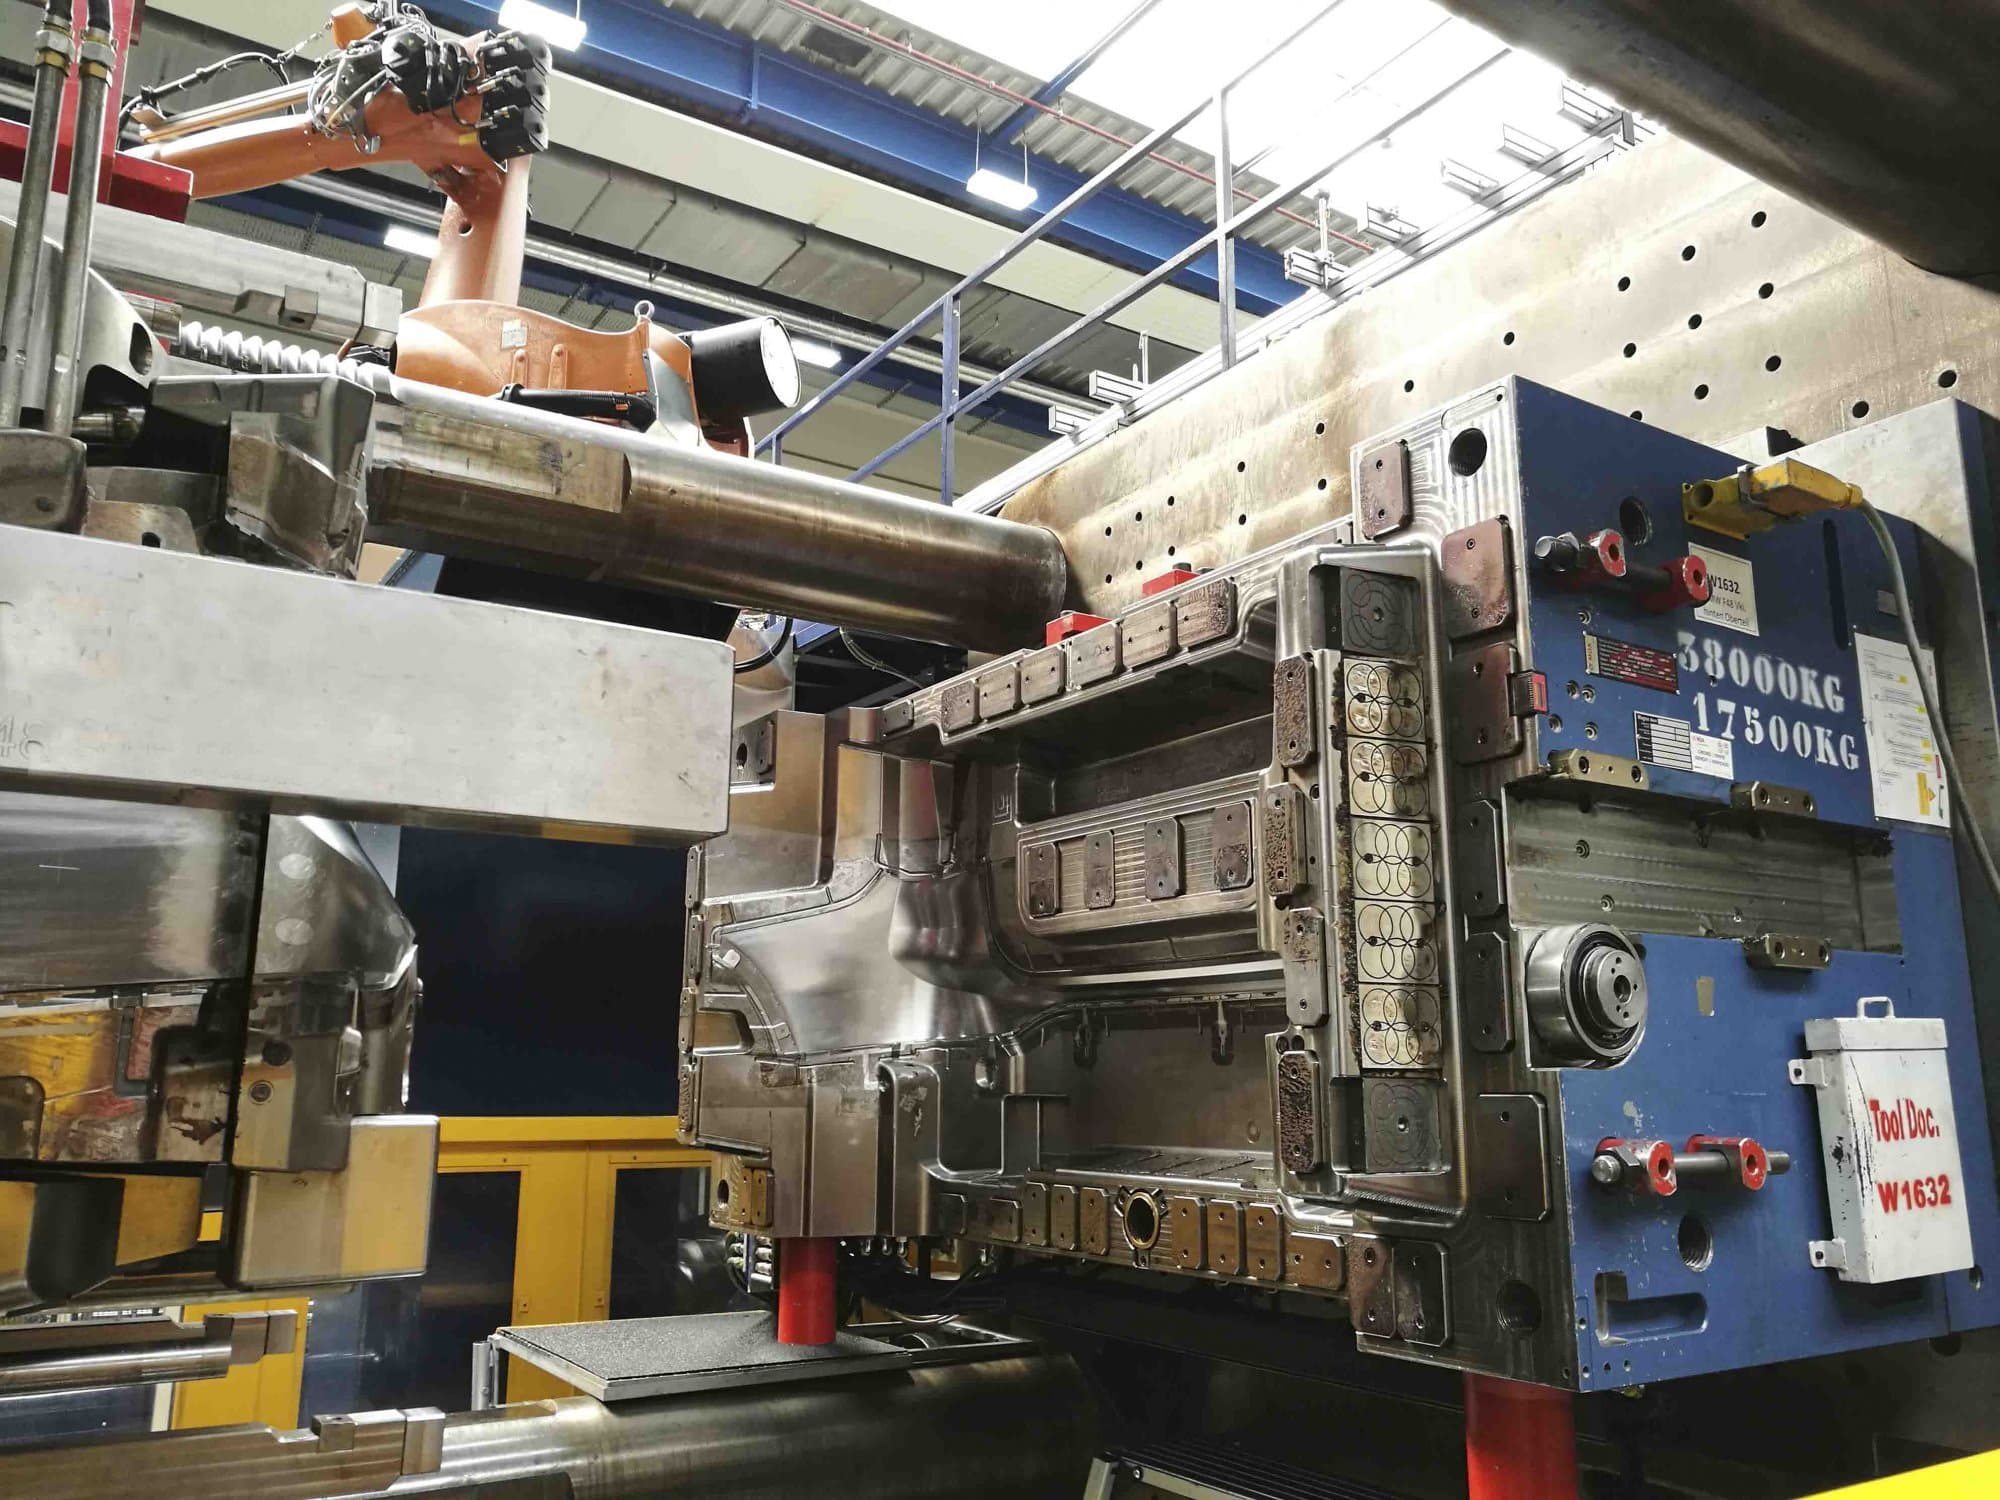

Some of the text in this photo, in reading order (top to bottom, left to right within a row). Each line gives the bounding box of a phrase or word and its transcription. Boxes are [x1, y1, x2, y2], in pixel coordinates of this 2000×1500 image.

[1706, 573, 1741, 594] W1632
[1677, 631, 1845, 713] 38000KG
[1693, 692, 1859, 770] 17500KG
[1869, 1097, 1940, 1142] Tool Doc.
